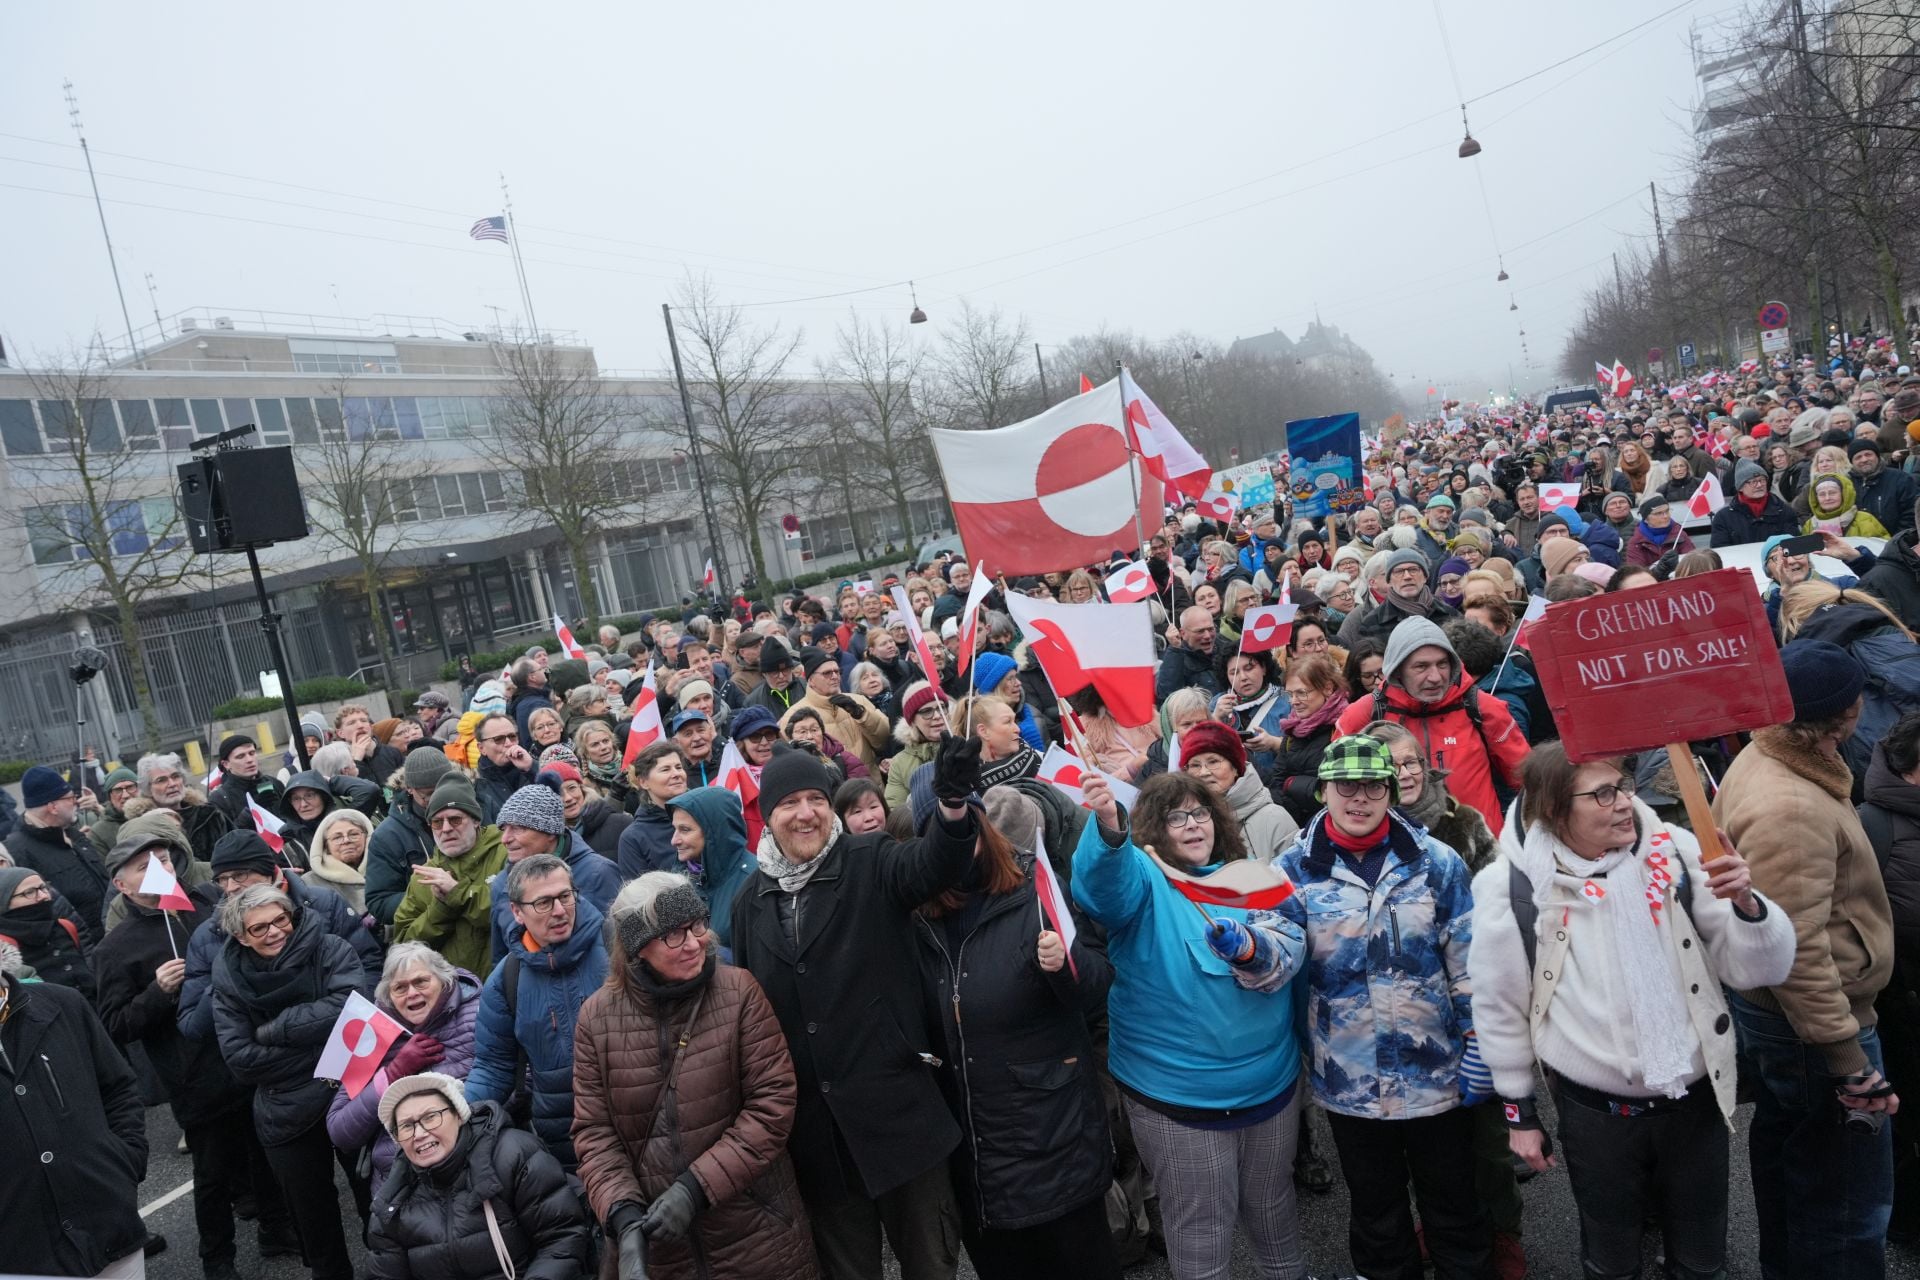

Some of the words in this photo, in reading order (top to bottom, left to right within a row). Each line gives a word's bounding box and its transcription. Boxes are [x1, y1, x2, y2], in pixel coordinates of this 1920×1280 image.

[1682, 345, 1691, 357] P
[199, 525, 207, 537] 1
[1576, 590, 1716, 641] GREENLAND
[1577, 654, 1628, 686] NOT
[1643, 648, 1692, 674] FOR
[1696, 634, 1749, 664] SALE!
